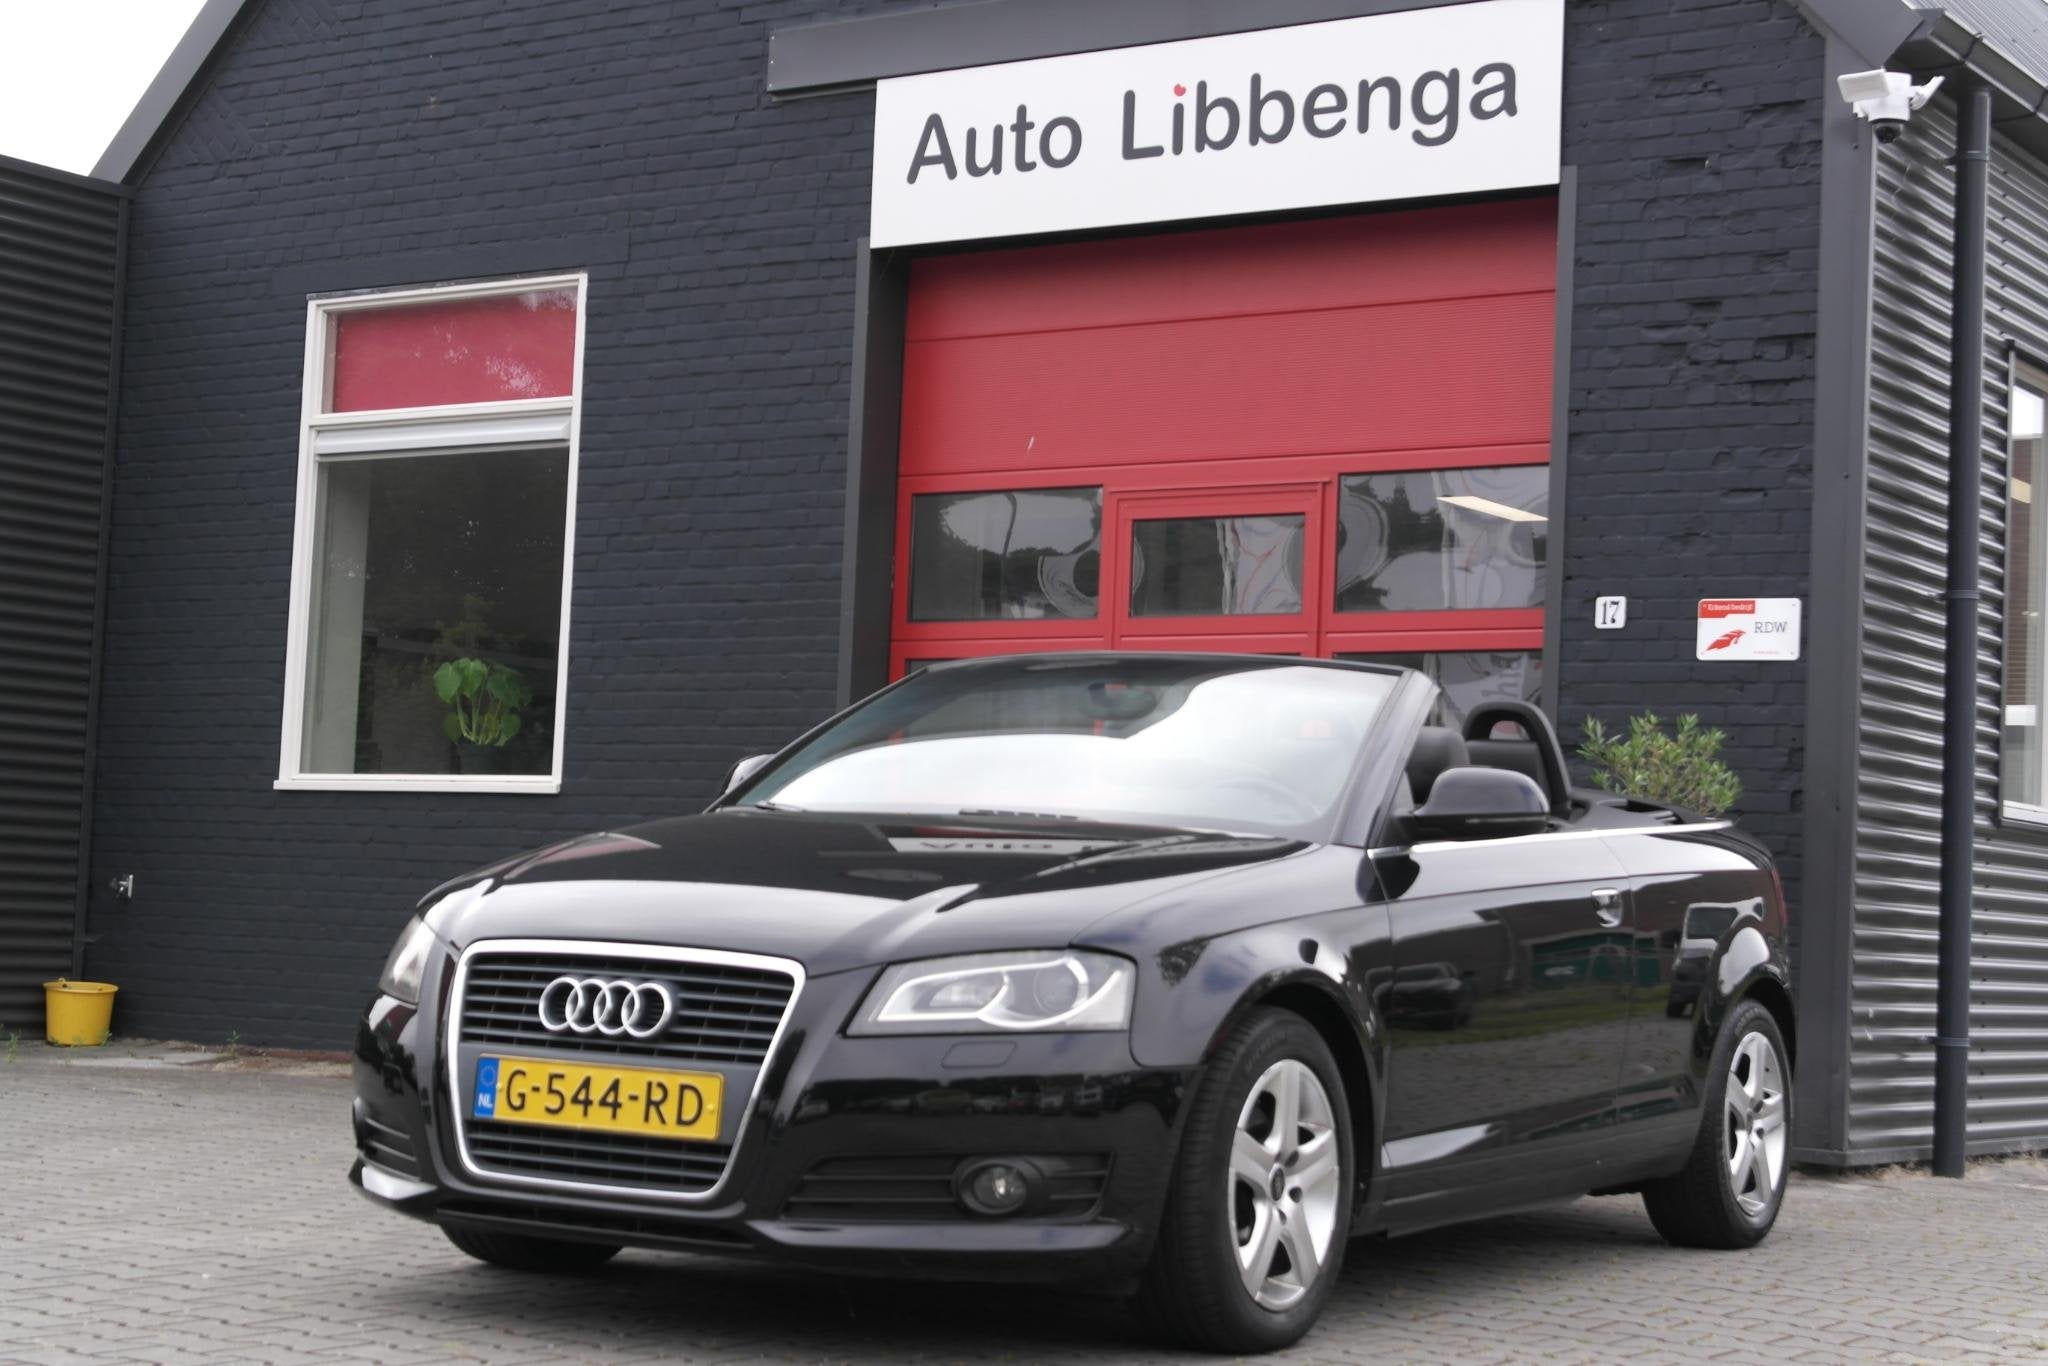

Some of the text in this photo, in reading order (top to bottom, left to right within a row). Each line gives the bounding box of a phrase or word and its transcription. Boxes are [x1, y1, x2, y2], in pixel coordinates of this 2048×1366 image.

[907, 62, 1518, 184] Auto Libbenga
[1601, 601, 1620, 625] 17
[1754, 621, 1787, 633] RDW
[477, 1094, 494, 1108] NL
[505, 1069, 704, 1126] G-544-RD
